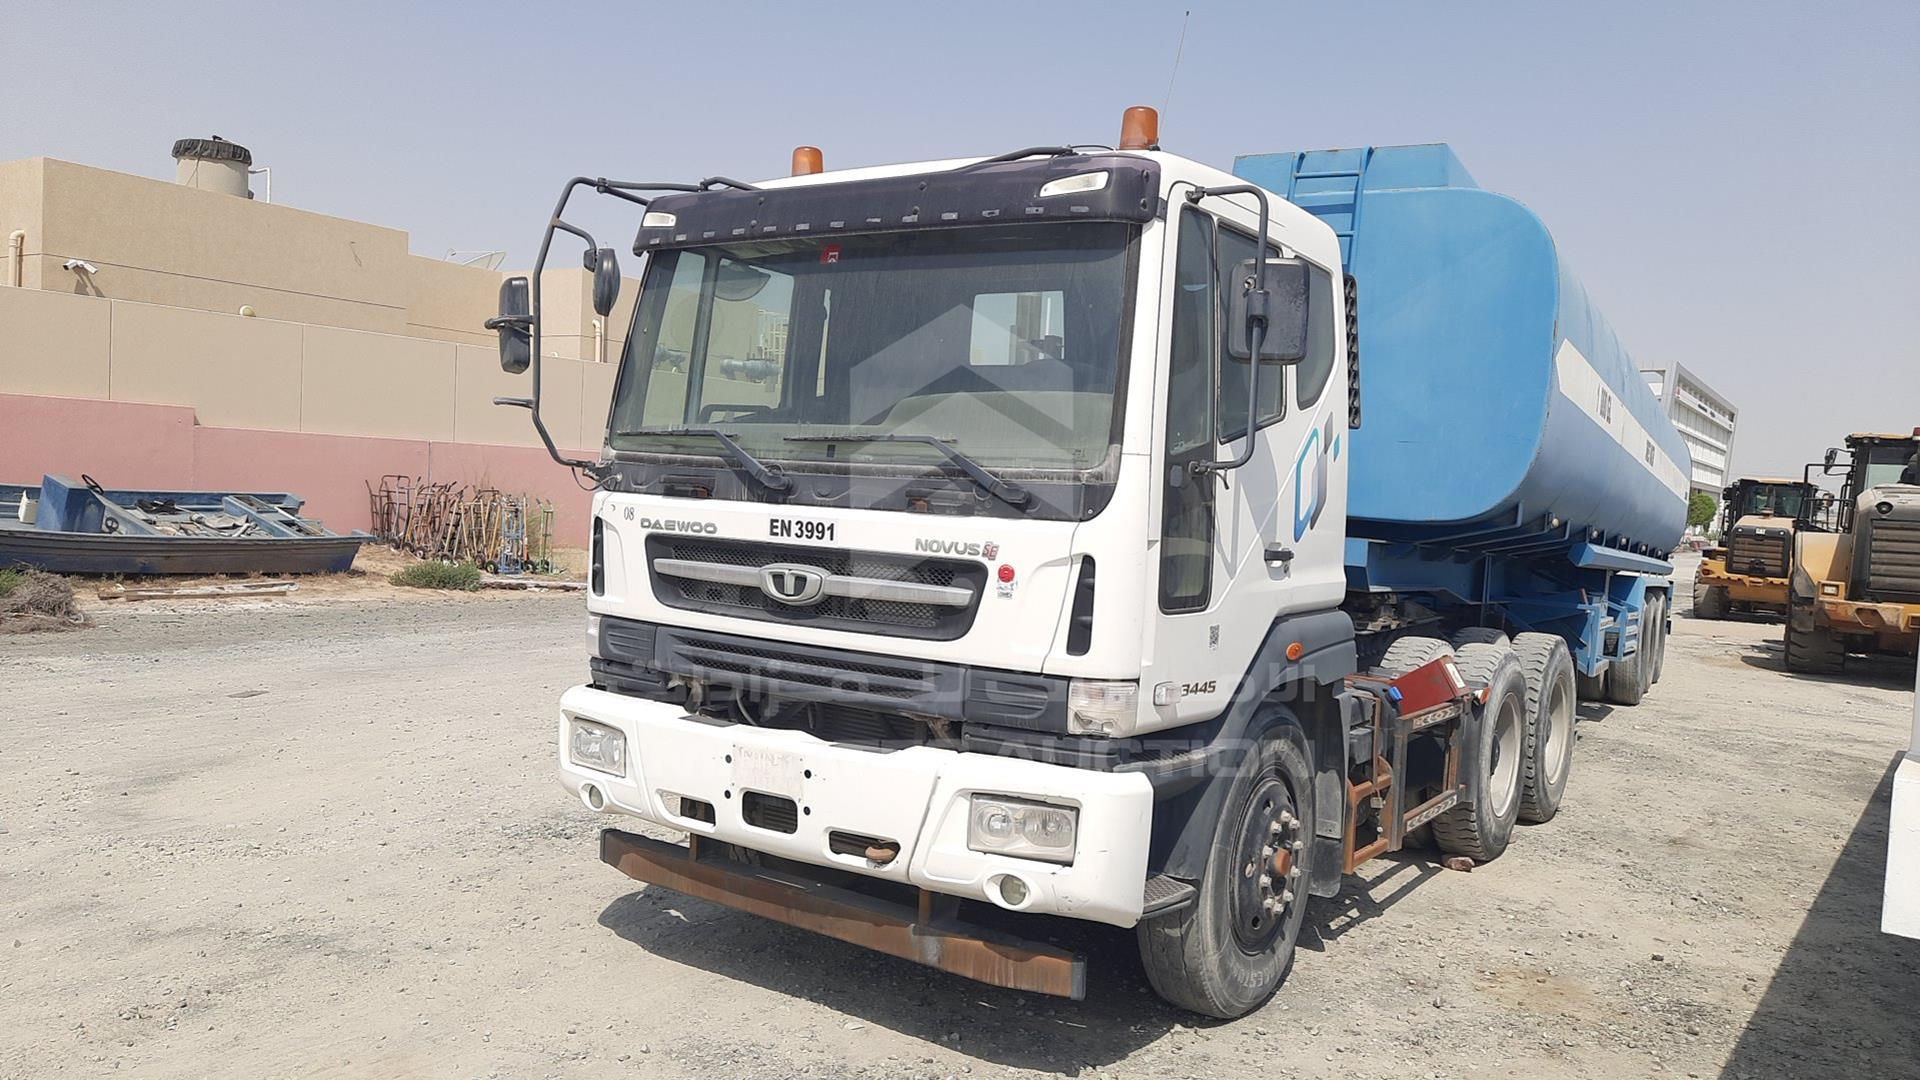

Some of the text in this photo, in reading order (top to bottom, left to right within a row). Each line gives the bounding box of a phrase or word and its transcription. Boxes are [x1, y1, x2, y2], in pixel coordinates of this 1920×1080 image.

[623, 506, 634, 521] 08
[640, 518, 718, 534] DAEWOO
[915, 538, 981, 556] NOVUS
[1181, 681, 1216, 697] 3445
